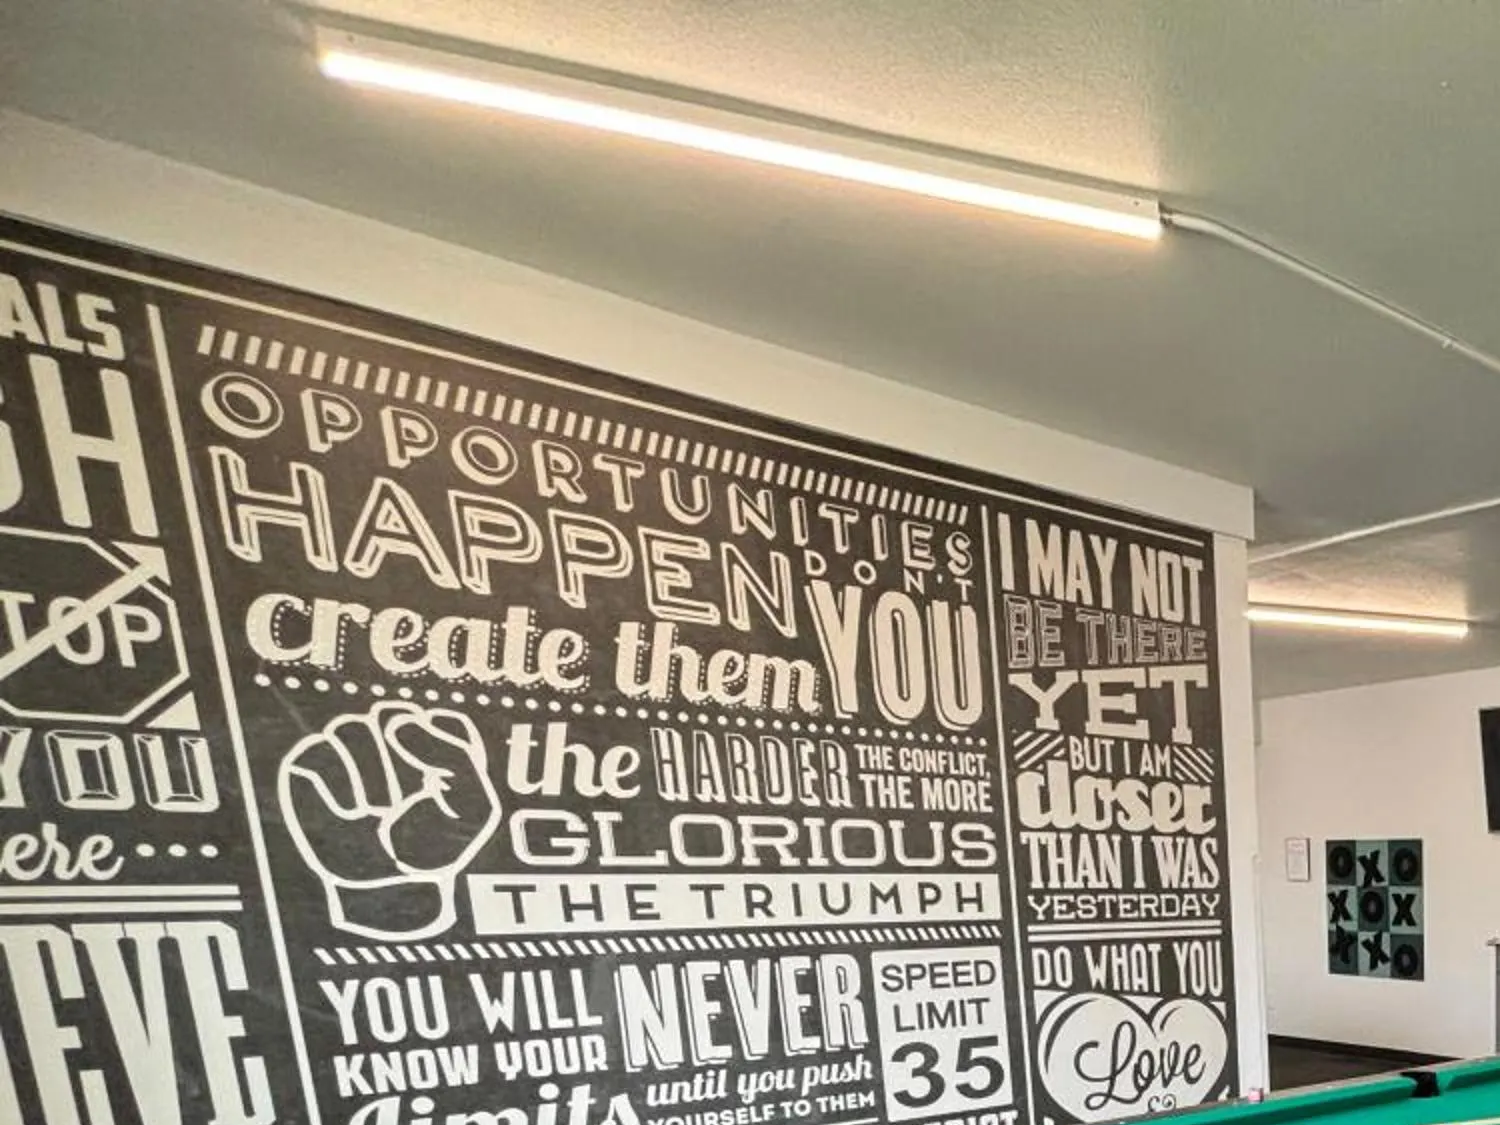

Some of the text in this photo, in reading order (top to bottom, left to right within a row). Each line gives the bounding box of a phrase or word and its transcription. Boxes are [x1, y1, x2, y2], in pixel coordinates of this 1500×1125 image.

[0, 272, 126, 361] ALS
[0, 353, 159, 538] H
[201, 371, 973, 576] OPPORTUNITIES
[208, 446, 798, 639] HAPPEN
[997, 512, 1204, 626] I MAY NOT
[246, 593, 825, 714] create them
[805, 578, 984, 732] YOU
[1003, 593, 1208, 669] BE THERE
[1008, 664, 1209, 745] YET
[506, 721, 854, 808] the HARDER
[854, 743, 894, 773] THE
[859, 774, 994, 814] THE MORE
[1069, 735, 1172, 778] BUT I AM
[1016, 759, 1217, 834] closer
[509, 808, 998, 868] GLORIOUS
[1020, 830, 1220, 890] THAN I WAS
[493, 881, 984, 925] THE TRIUMPH
[1027, 892, 1221, 920] YESTERDAY
[319, 966, 603, 1046] YOU WILL
[881, 958, 997, 993] SPEED
[1032, 939, 1223, 998] DO WHAT YOU
[614, 952, 870, 1074] NEVER
[892, 996, 991, 1033] LIMIT
[333, 1034, 608, 1098] KNOW YOUR
[646, 1053, 873, 1108] until you push
[889, 1034, 1006, 1109] 35
[1073, 1020, 1206, 1111] Love
[779, 1100, 812, 1119] TO
[815, 1090, 876, 1112] THEM
